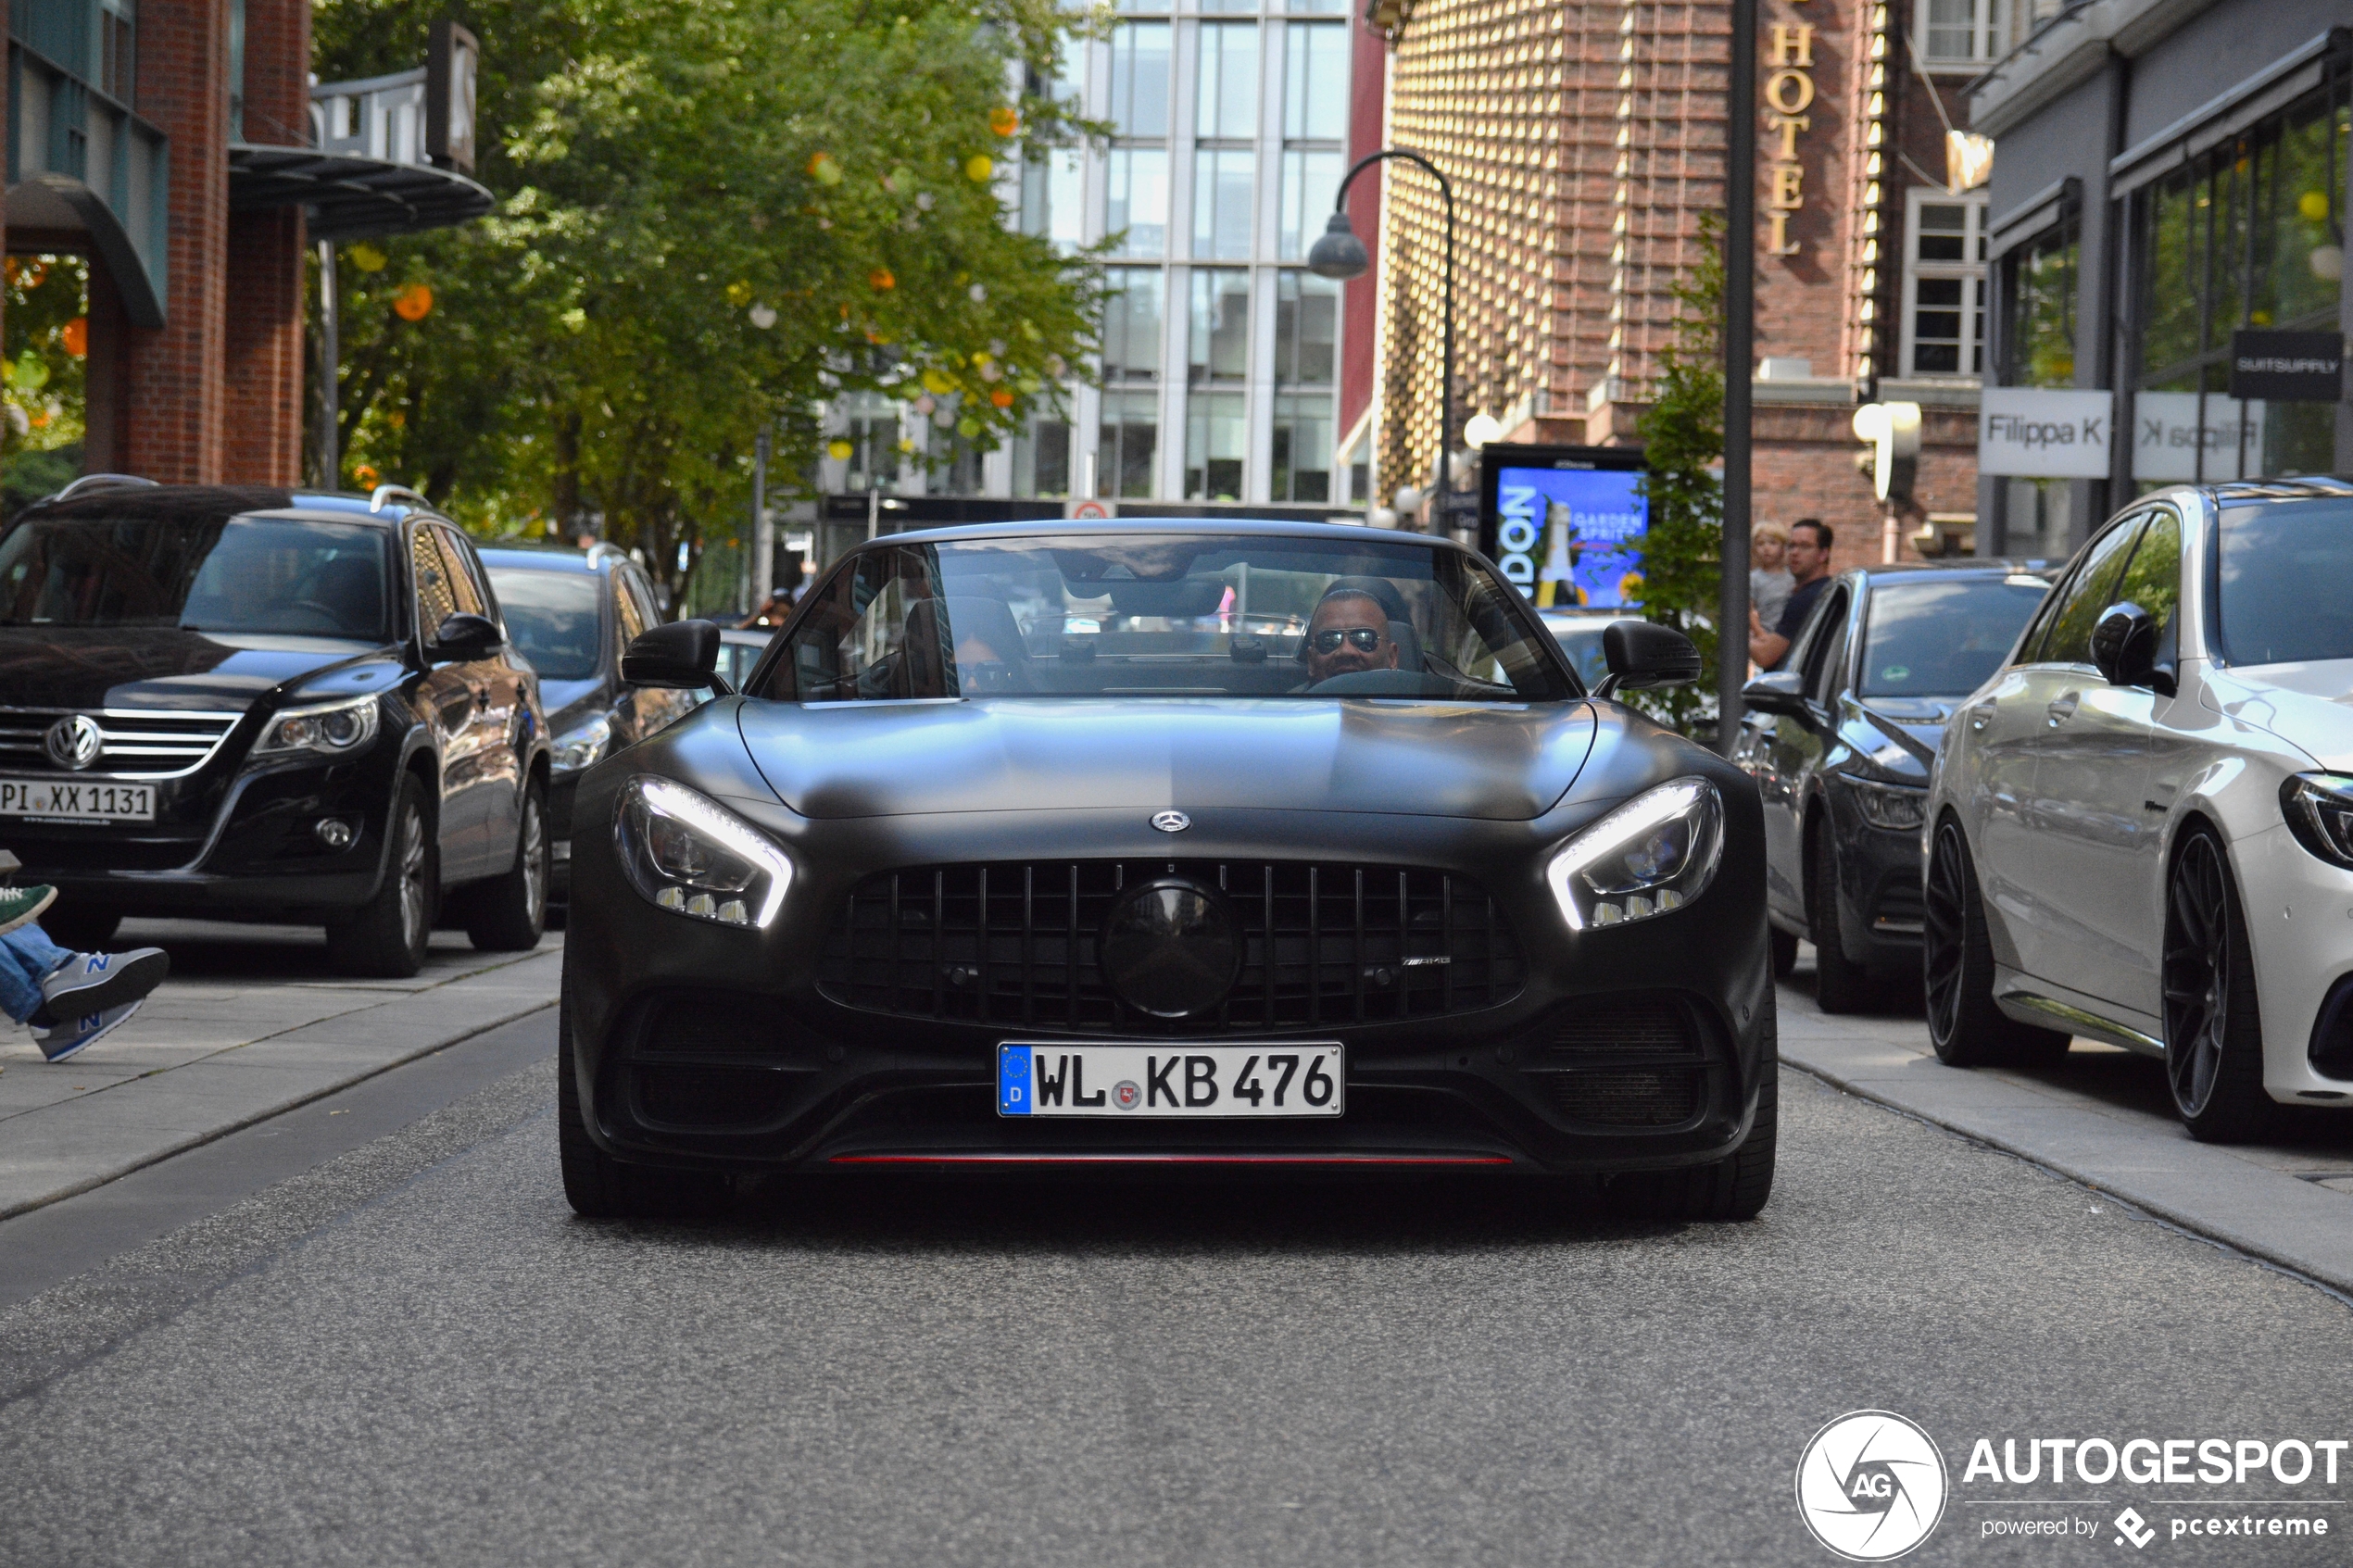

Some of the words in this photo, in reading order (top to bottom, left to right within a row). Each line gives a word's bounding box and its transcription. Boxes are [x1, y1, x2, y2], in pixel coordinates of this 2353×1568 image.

[1767, 22, 1815, 256] HOTEL
[2237, 357, 2339, 374] SUITSUPPLY
[1988, 414, 2074, 449] Filippa
[2083, 418, 2103, 445] K
[2, 784, 29, 811] PI
[50, 786, 81, 812] XX
[88, 788, 149, 815] 1131
[1010, 1086, 1022, 1102] D
[1035, 1054, 1106, 1107] WL
[1148, 1055, 1219, 1108] KB
[1233, 1054, 1334, 1107] 476
